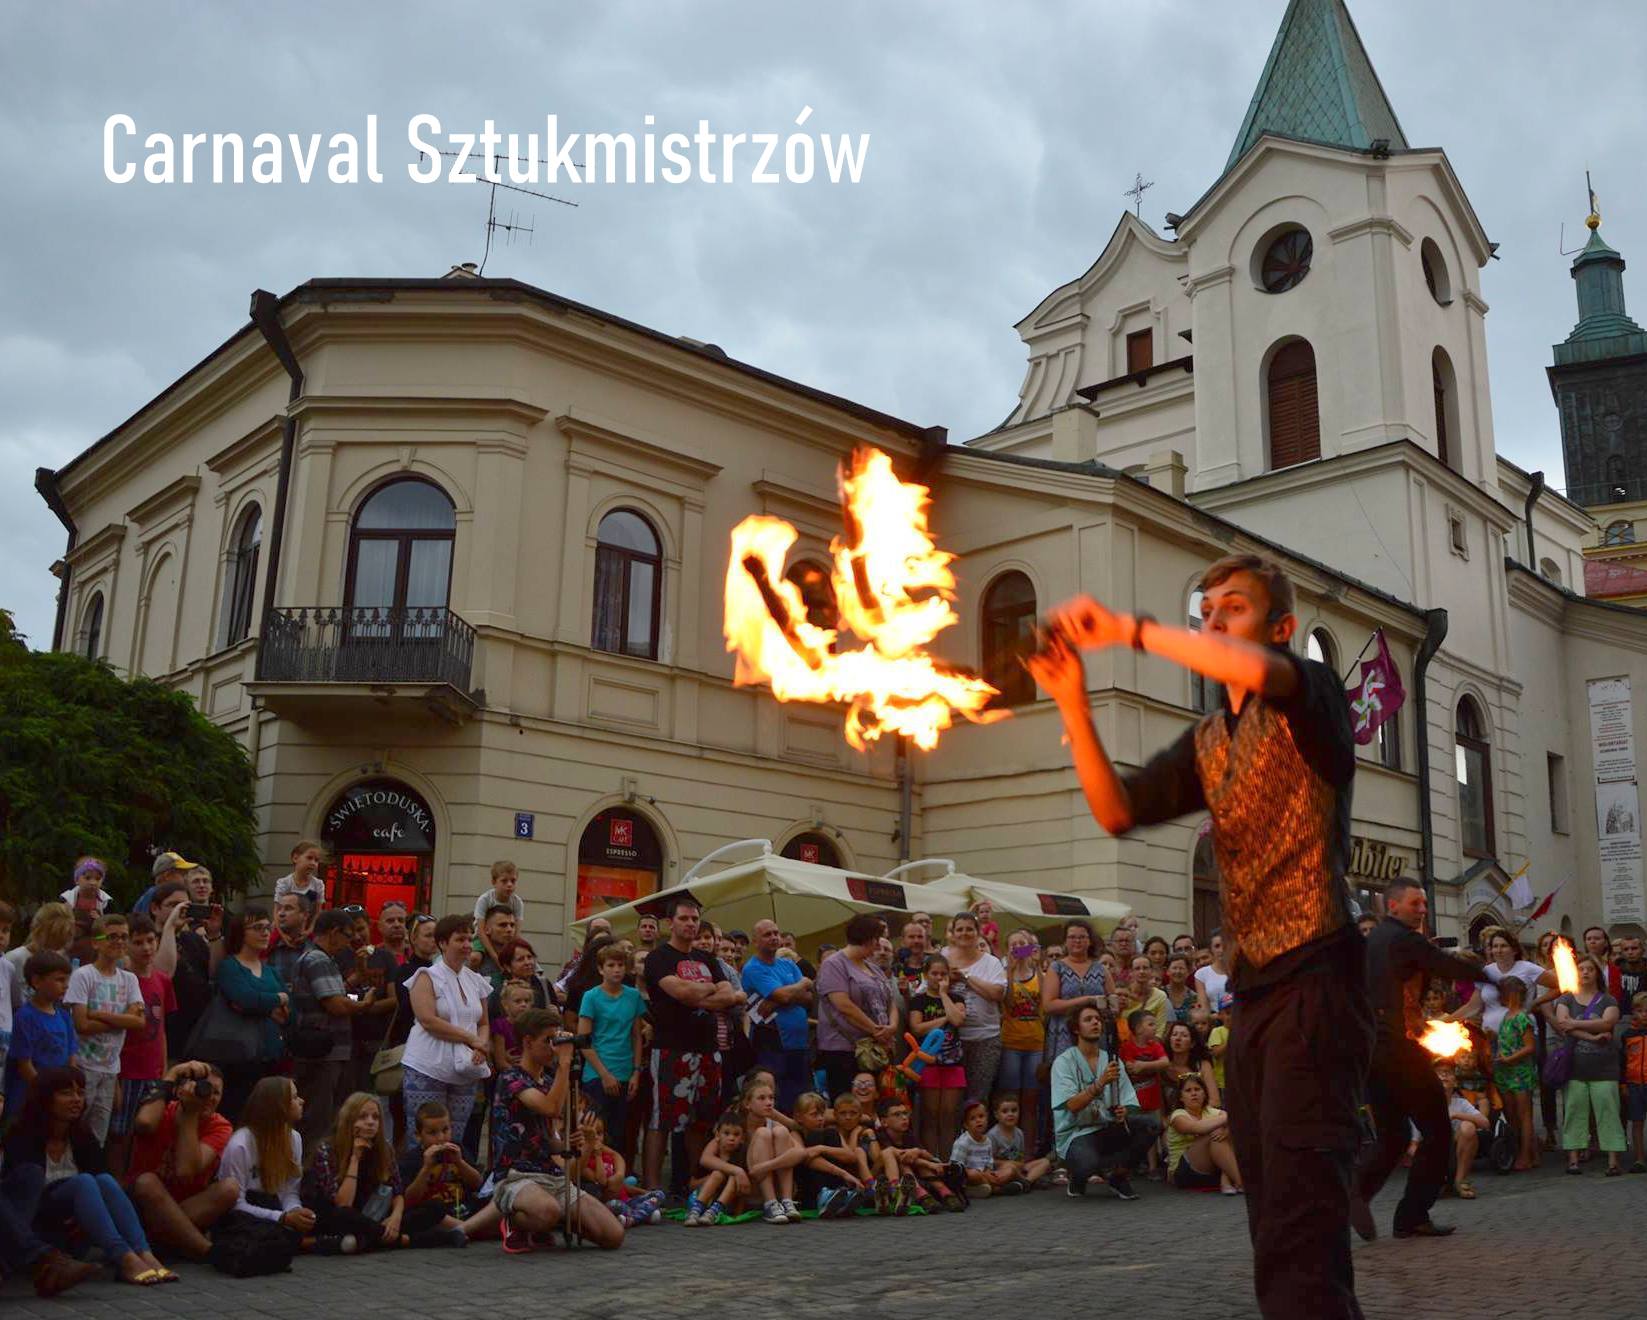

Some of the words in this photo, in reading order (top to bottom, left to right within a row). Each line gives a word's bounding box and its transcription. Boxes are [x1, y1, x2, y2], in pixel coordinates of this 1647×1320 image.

[373, 822, 405, 842] cafe
[520, 822, 528, 835] 3
[1347, 838, 1408, 880] ubiler
